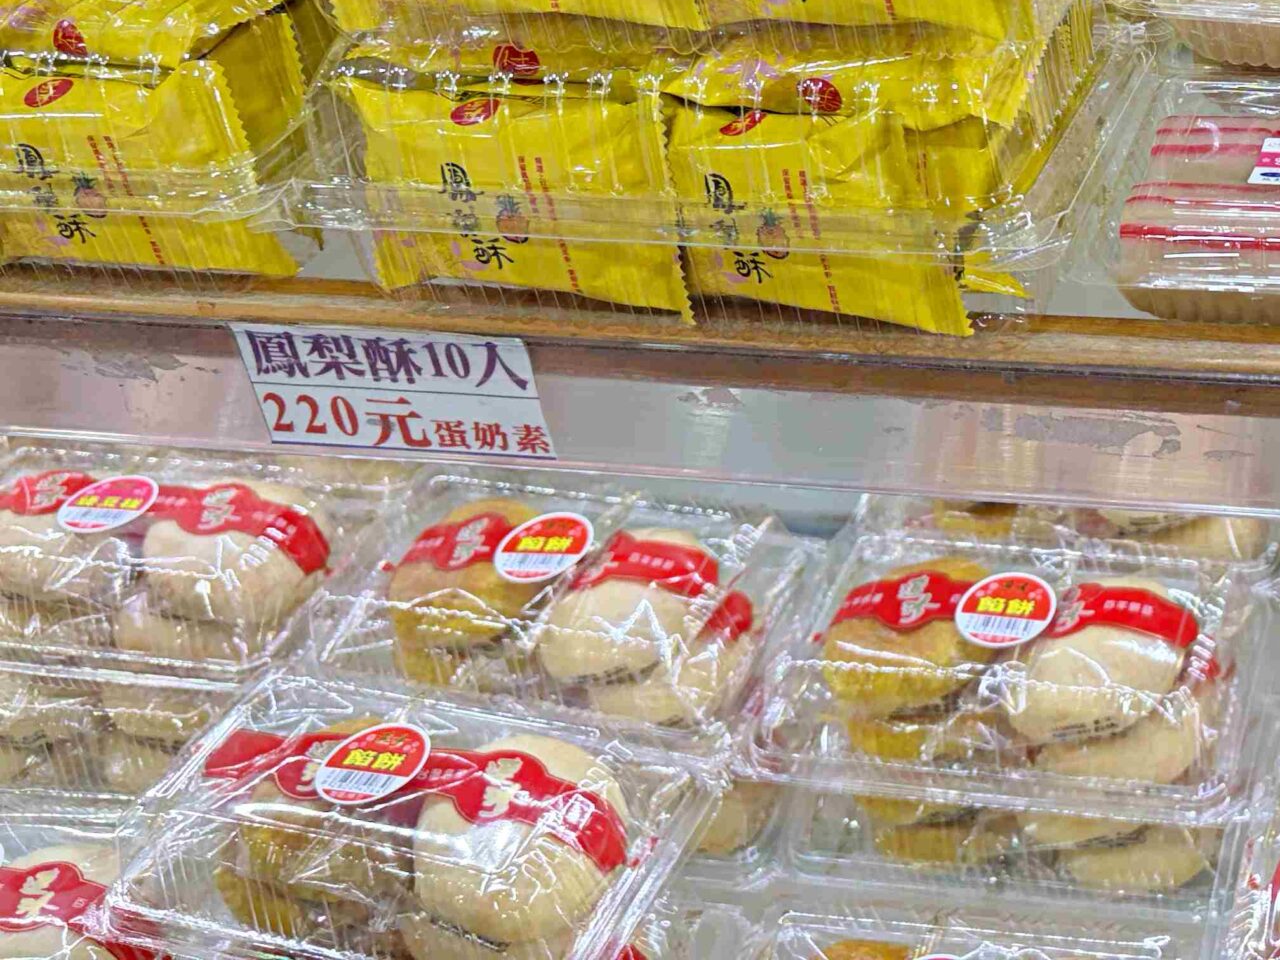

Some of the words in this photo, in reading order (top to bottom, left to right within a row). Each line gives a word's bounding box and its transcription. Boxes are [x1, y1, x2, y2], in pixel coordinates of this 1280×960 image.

[263, 391, 432, 448] 220元
[430, 419, 551, 454] 蛋奶素
[976, 595, 1035, 616] 餡餅
[342, 748, 407, 772] 餡餅
